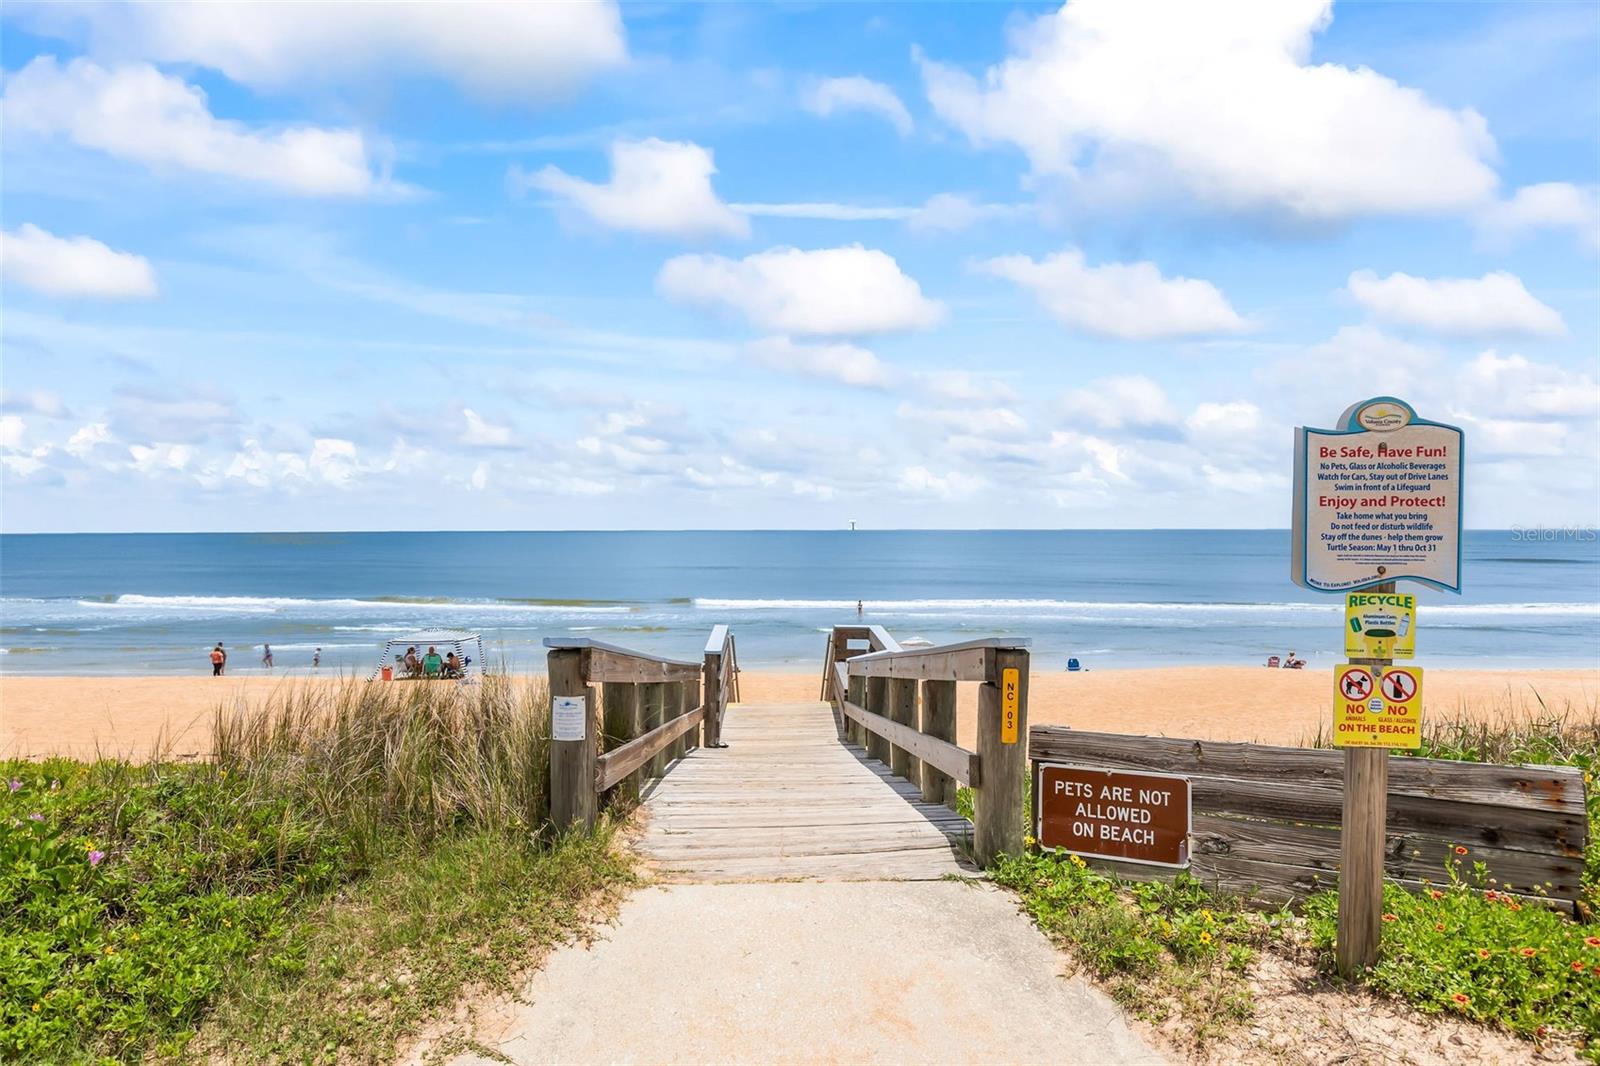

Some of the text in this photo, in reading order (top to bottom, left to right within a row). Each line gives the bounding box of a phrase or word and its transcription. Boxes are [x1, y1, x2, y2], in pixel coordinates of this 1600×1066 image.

[1320, 446, 1446, 459] Be Safe, Have Fun!
[1410, 463, 1445, 471] Beverages
[1352, 473, 1368, 481] Cars,
[1369, 473, 1384, 482] Stay
[1397, 484, 1430, 492] Lifeguard
[1320, 496, 1445, 509] Enjoy and Protect!
[1409, 513, 1427, 521] bring
[1321, 534, 1336, 542] Stay
[1388, 534, 1403, 542] help
[1425, 535, 1443, 543] grow
[1377, 544, 1392, 553] May
[1349, 596, 1412, 609] RECYCLE
[1006, 682, 1015, 729] NC-03
[1346, 705, 1365, 713] NO
[1388, 706, 1407, 715] NO
[1379, 725, 1415, 734] BEACH
[1055, 780, 1171, 806] PETS ARE NOT
[1075, 803, 1151, 824] ALLOWED
[1073, 822, 1154, 845] ON BEACH
